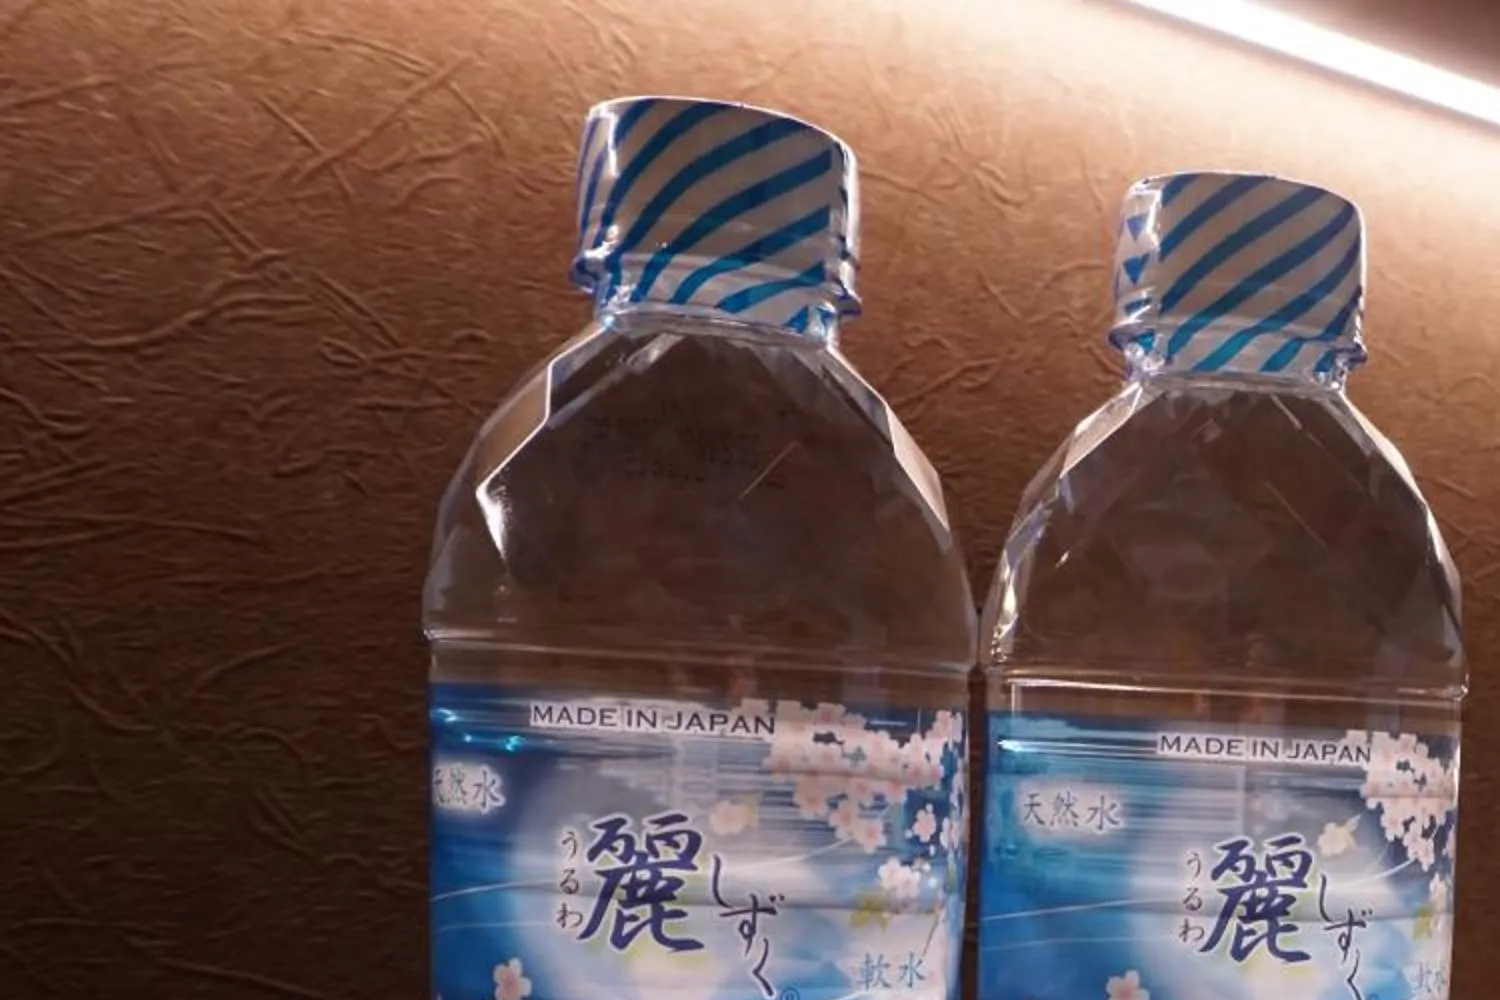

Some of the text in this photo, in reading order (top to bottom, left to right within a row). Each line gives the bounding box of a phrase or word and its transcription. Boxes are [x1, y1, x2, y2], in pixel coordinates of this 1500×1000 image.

[531, 704, 775, 735] MADE IN JAPAN
[1159, 735, 1373, 763] MADE IN JAPAN
[1023, 793, 1121, 832] 天然水
[556, 830, 584, 930] うるわ
[578, 813, 704, 951] 麗
[1179, 851, 1206, 943] うるわ
[1201, 836, 1313, 963] 麗
[711, 855, 785, 998] しずく
[857, 952, 925, 989] 軟水
